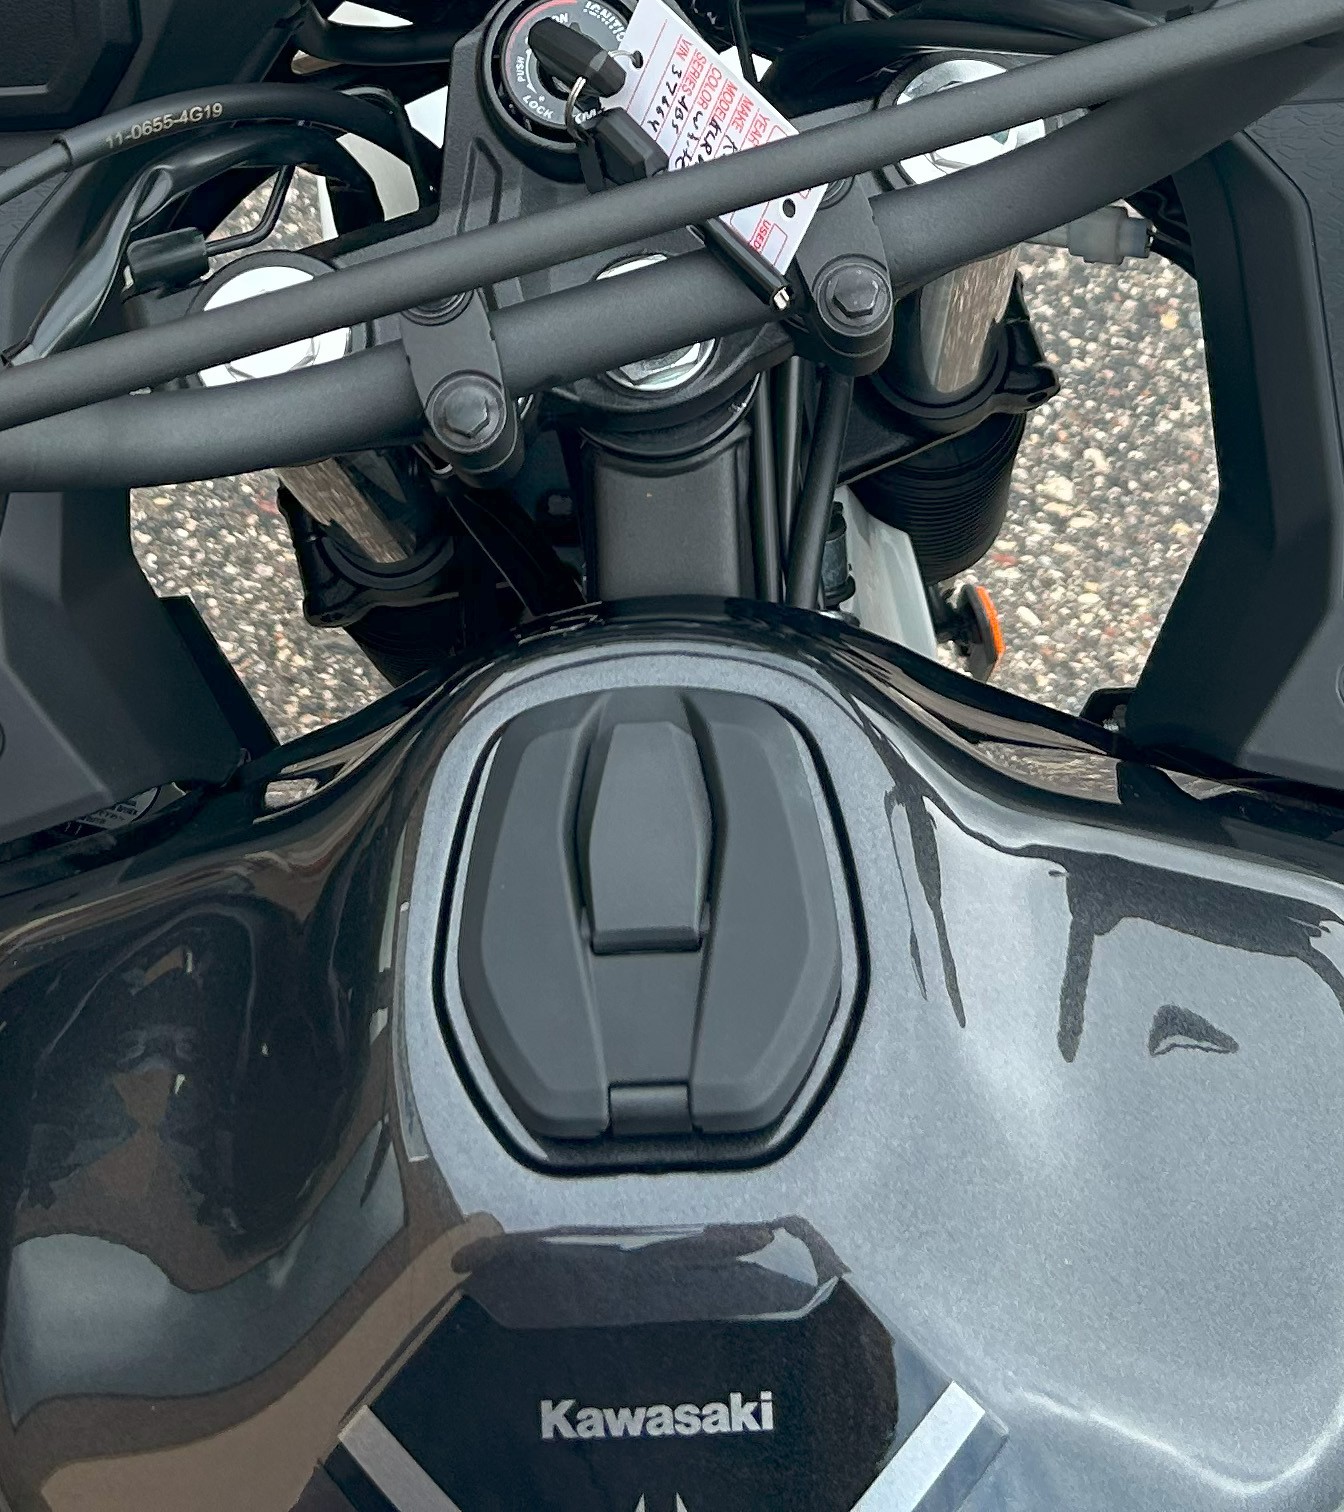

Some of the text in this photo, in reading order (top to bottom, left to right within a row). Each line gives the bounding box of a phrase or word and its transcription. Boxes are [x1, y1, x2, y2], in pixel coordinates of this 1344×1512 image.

[583, 1, 626, 42] IGNITIO
[516, 55, 526, 83] PUSH
[676, 38, 693, 62] VIN
[682, 51, 707, 97] SERIES
[697, 67, 723, 111] COLOR
[522, 94, 554, 119] LOCK
[716, 82, 738, 123] MODEL
[732, 96, 755, 135] MAKE
[105, 102, 223, 149] 11-0655-4G19
[754, 219, 772, 250] USED
[540, 1390, 775, 1440] Kawasaki
